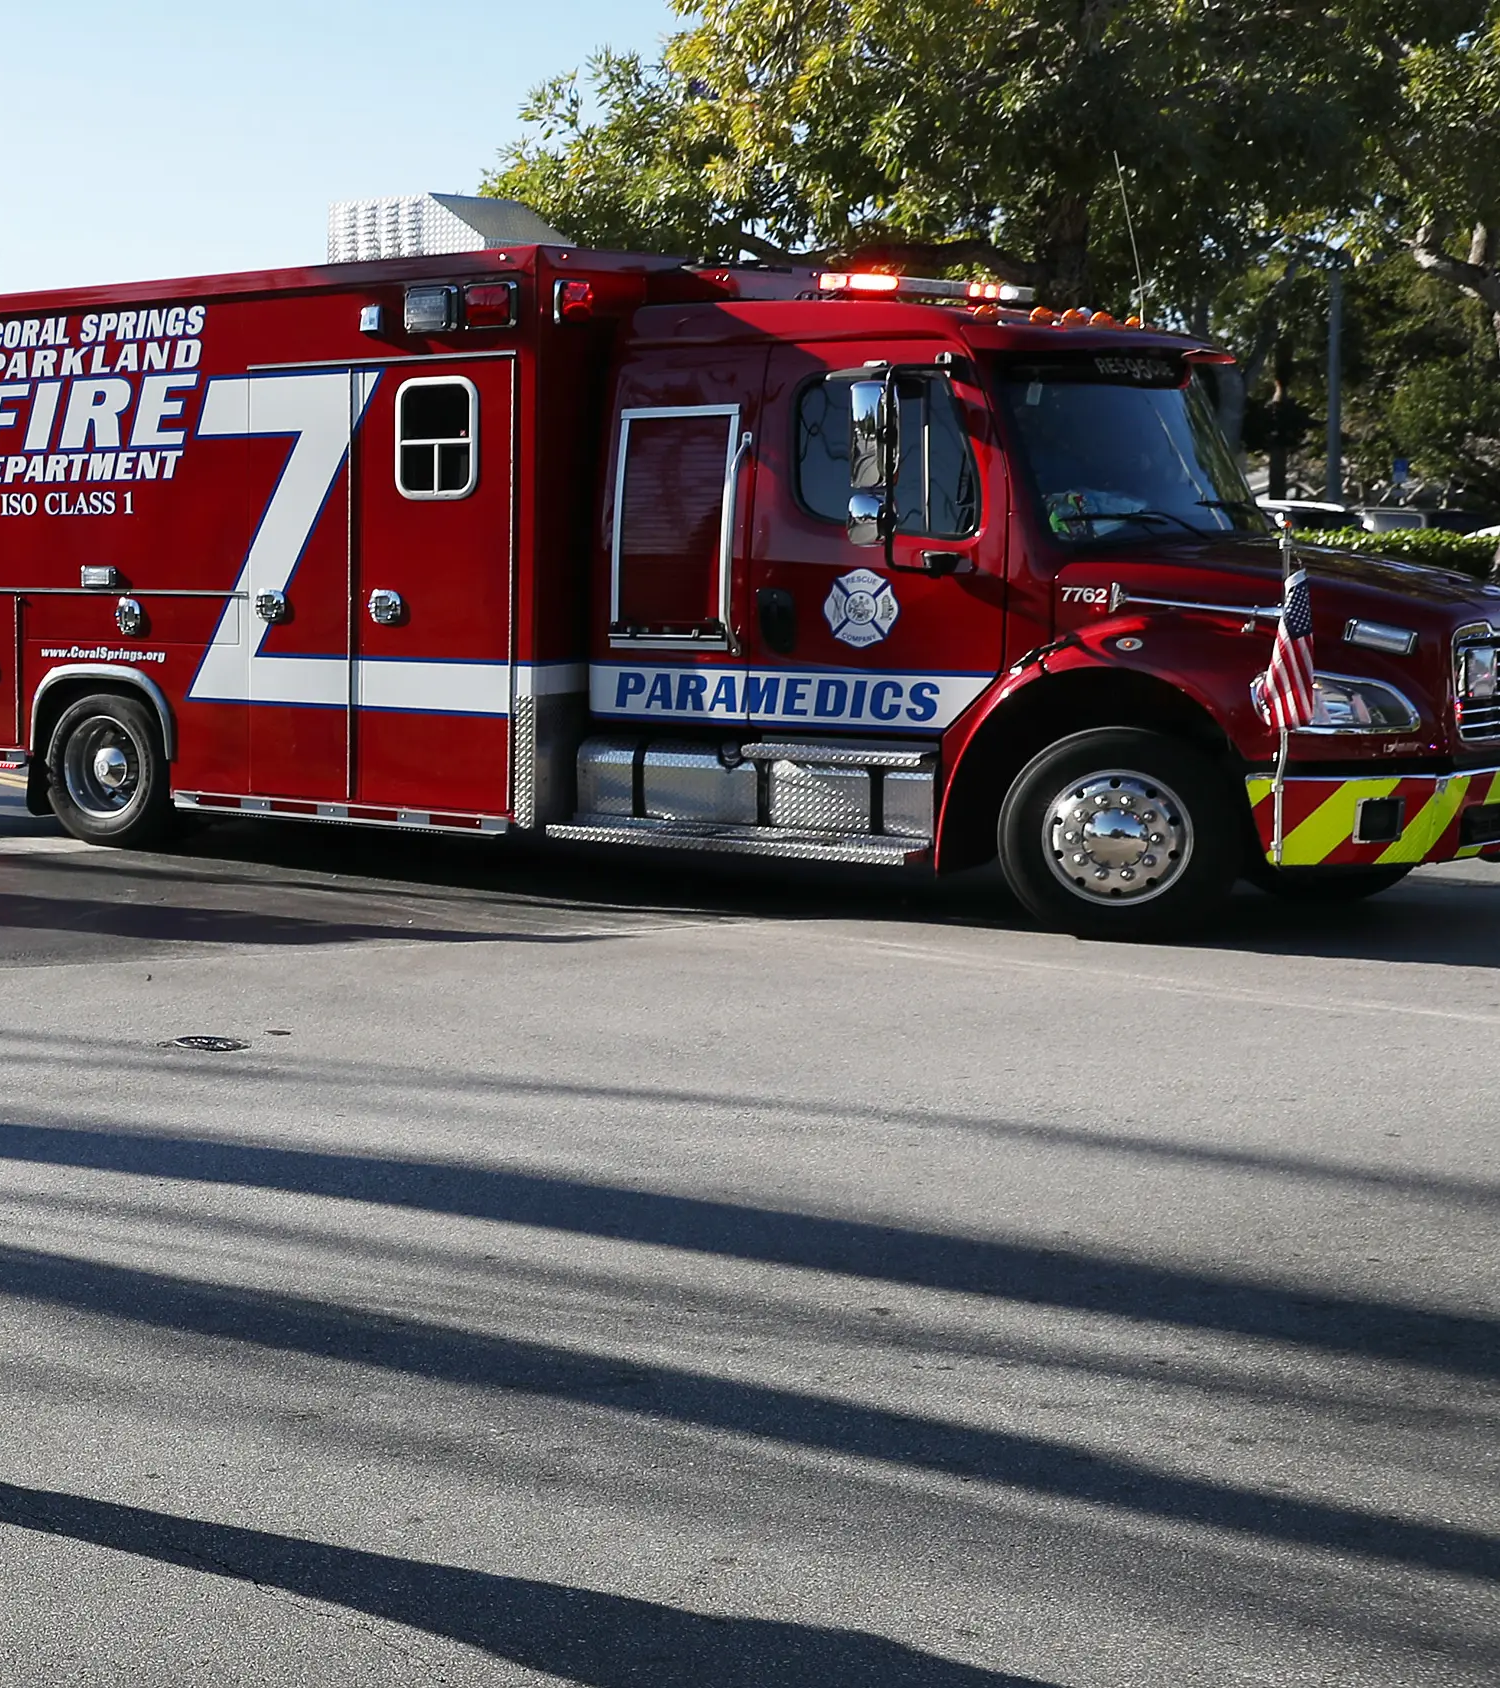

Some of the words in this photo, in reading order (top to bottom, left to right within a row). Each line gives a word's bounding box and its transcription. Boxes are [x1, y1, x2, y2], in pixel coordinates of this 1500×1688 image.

[80, 305, 206, 342] SPRINGS
[0, 493, 37, 516] ISO
[44, 491, 116, 515] CLASS
[123, 491, 134, 514] 1
[845, 575, 878, 585] RESCUE
[1061, 587, 1108, 603] 7762
[841, 632, 877, 642] COMPANY
[41, 646, 165, 663] www.CoralSprings.org
[614, 672, 941, 722] PARAMEDICS
